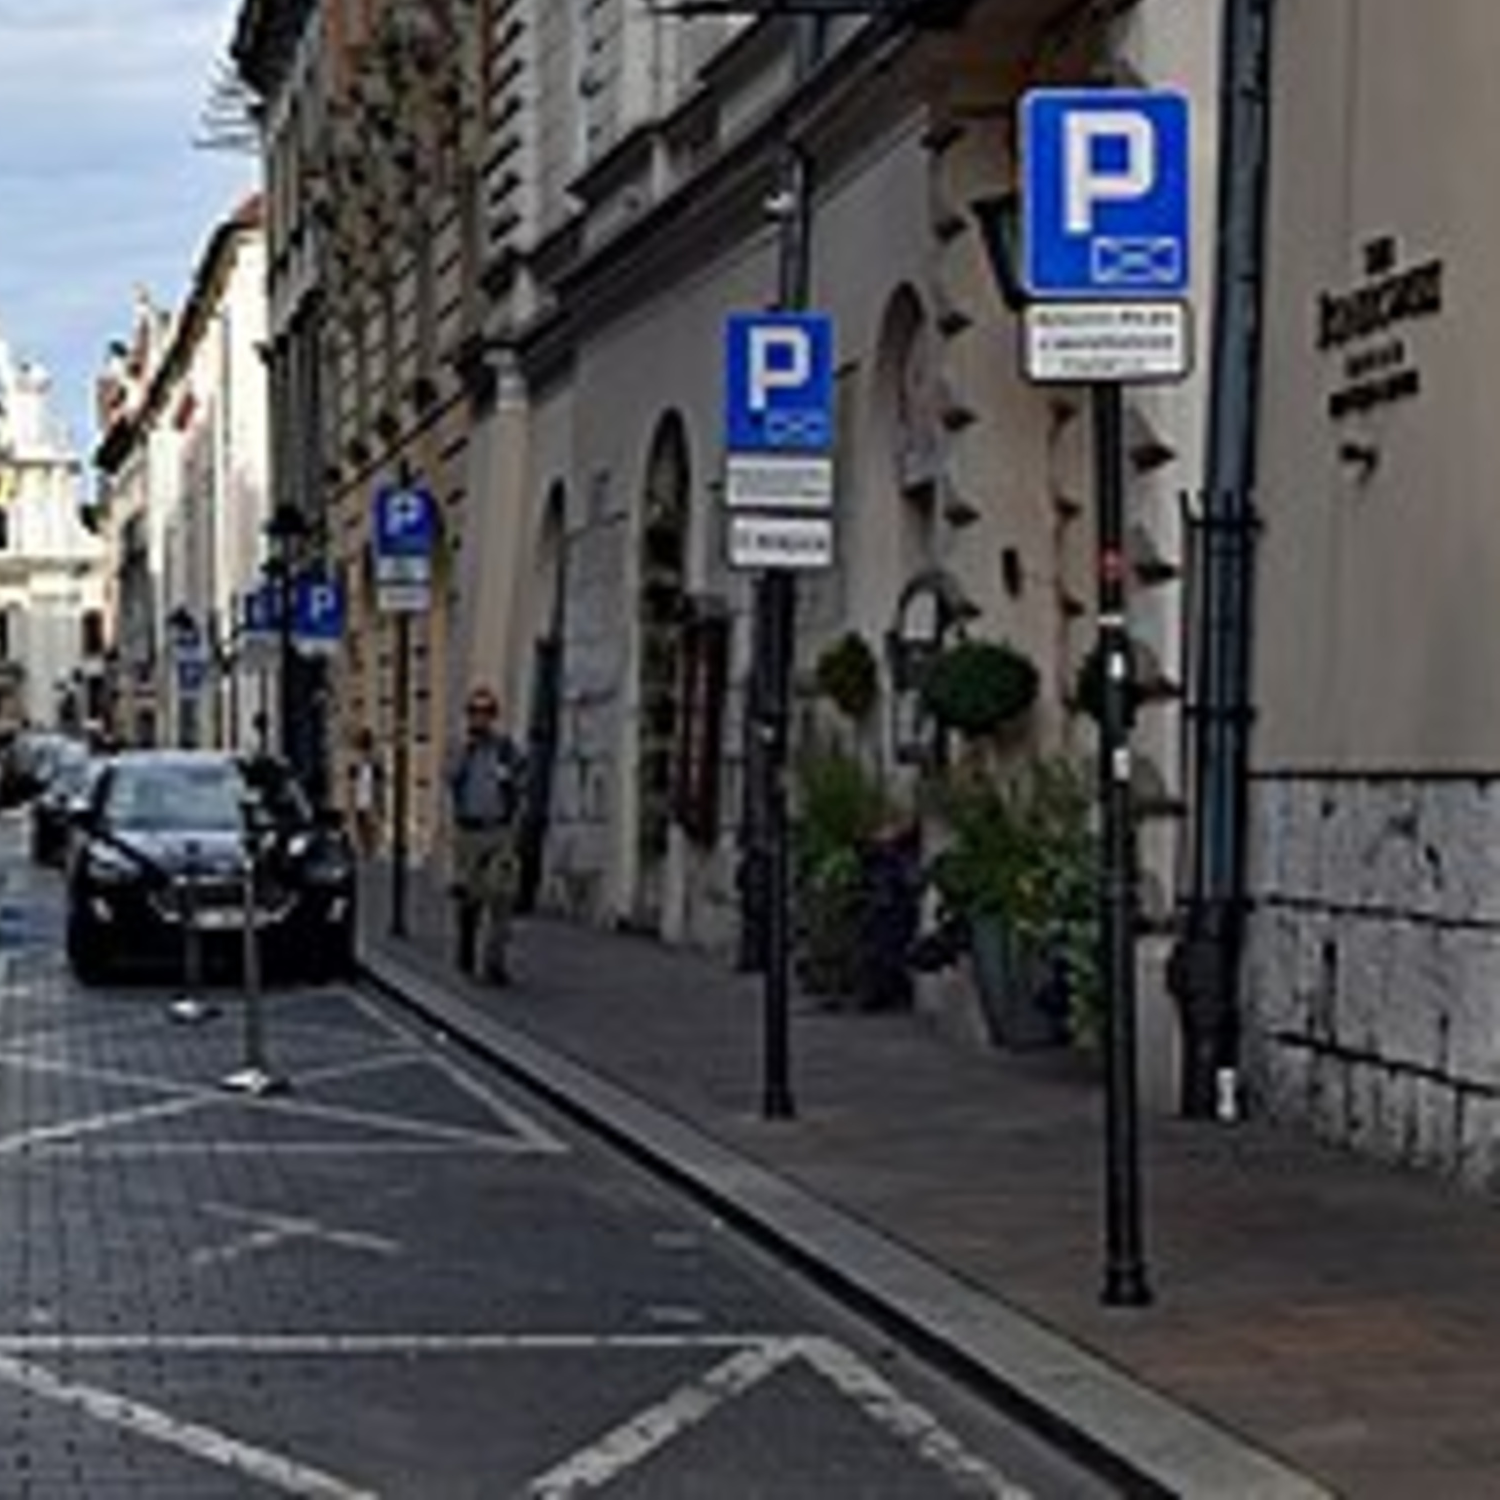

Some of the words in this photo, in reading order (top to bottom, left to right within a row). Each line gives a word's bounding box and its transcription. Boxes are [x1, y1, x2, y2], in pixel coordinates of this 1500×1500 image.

[1064, 110, 1156, 234] P
[748, 325, 810, 410] P
[386, 492, 425, 536] P
[310, 584, 336, 621] P
